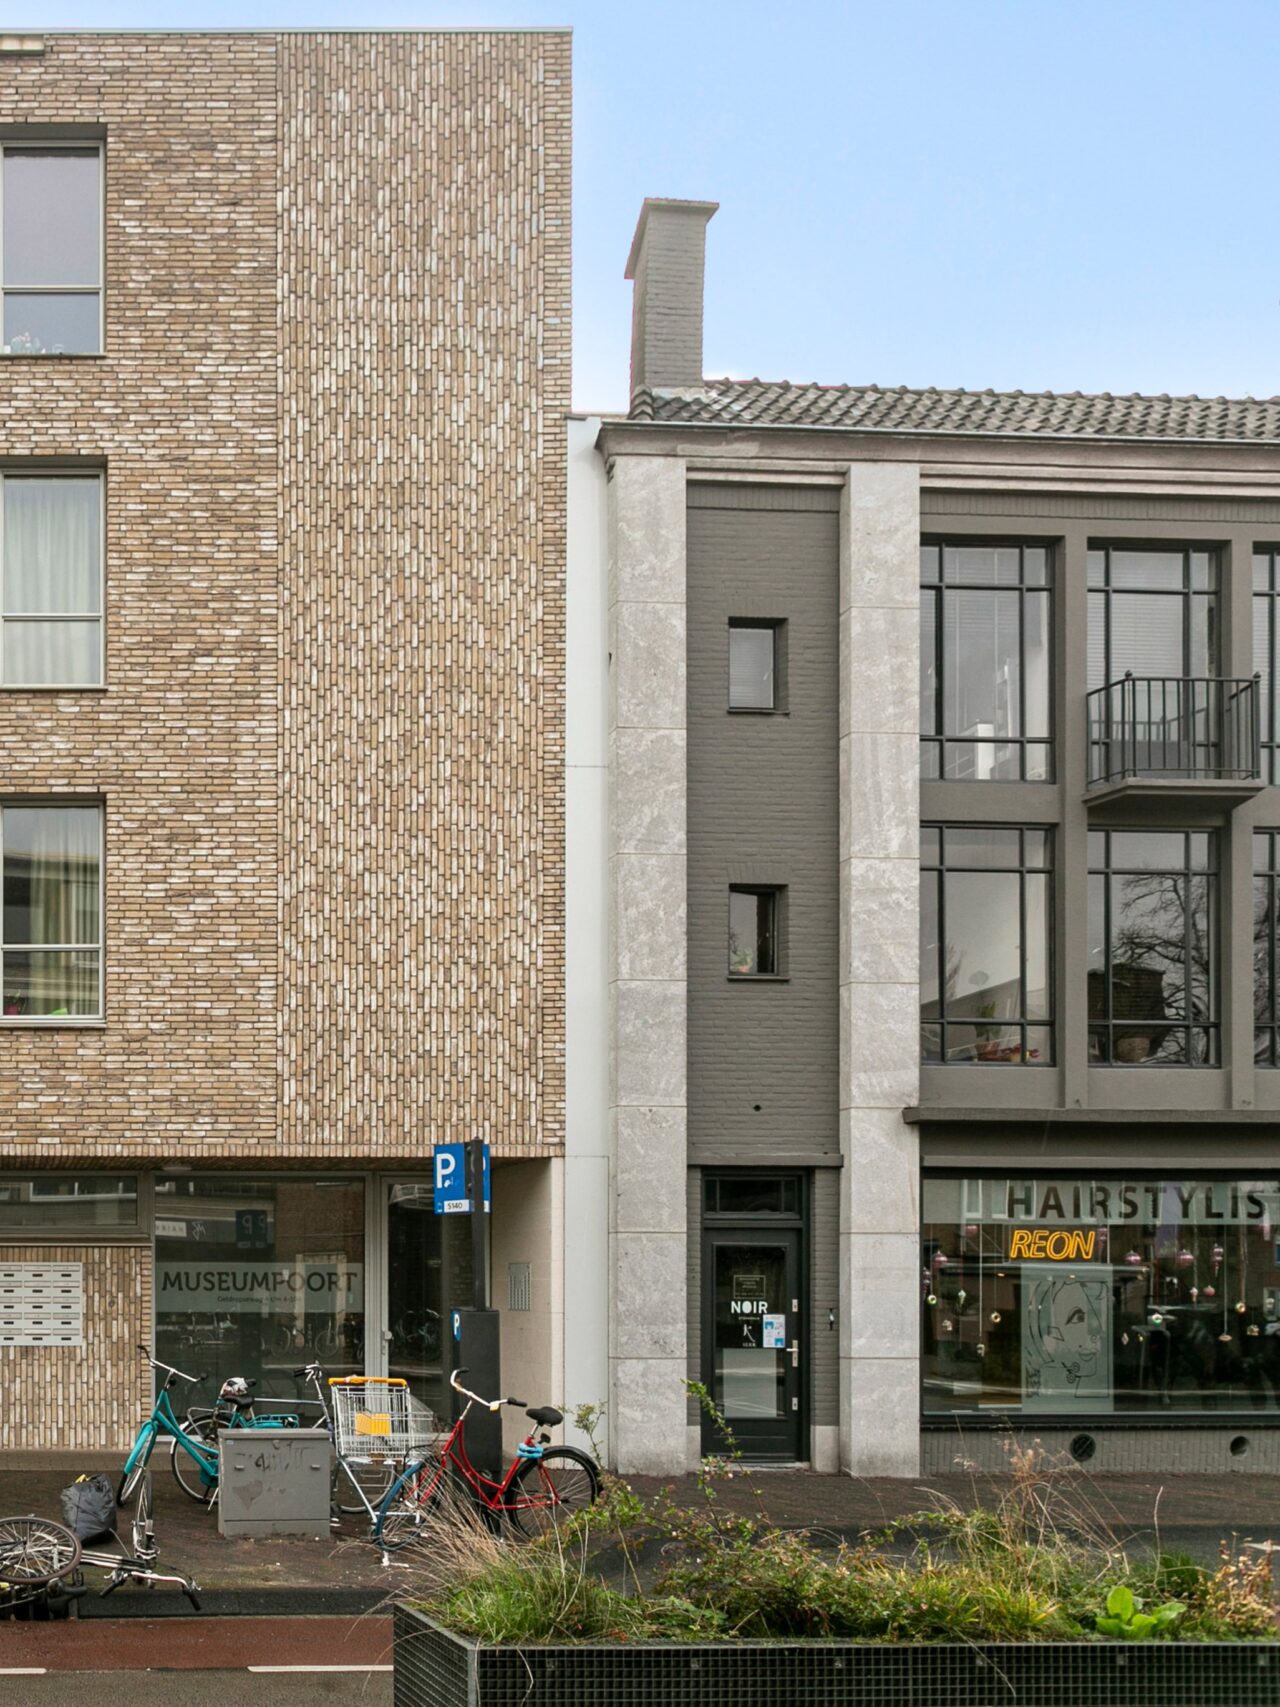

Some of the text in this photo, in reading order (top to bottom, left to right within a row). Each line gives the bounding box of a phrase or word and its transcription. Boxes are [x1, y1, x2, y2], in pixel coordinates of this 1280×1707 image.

[436, 1153, 456, 1189] P
[1007, 1185, 1280, 1220] HAIRSTYLIS
[1009, 1230, 1096, 1260] REON
[161, 1271, 358, 1292] MUSEUMPOORT
[730, 1300, 769, 1314] NOIR
[453, 1313, 461, 1336] P
